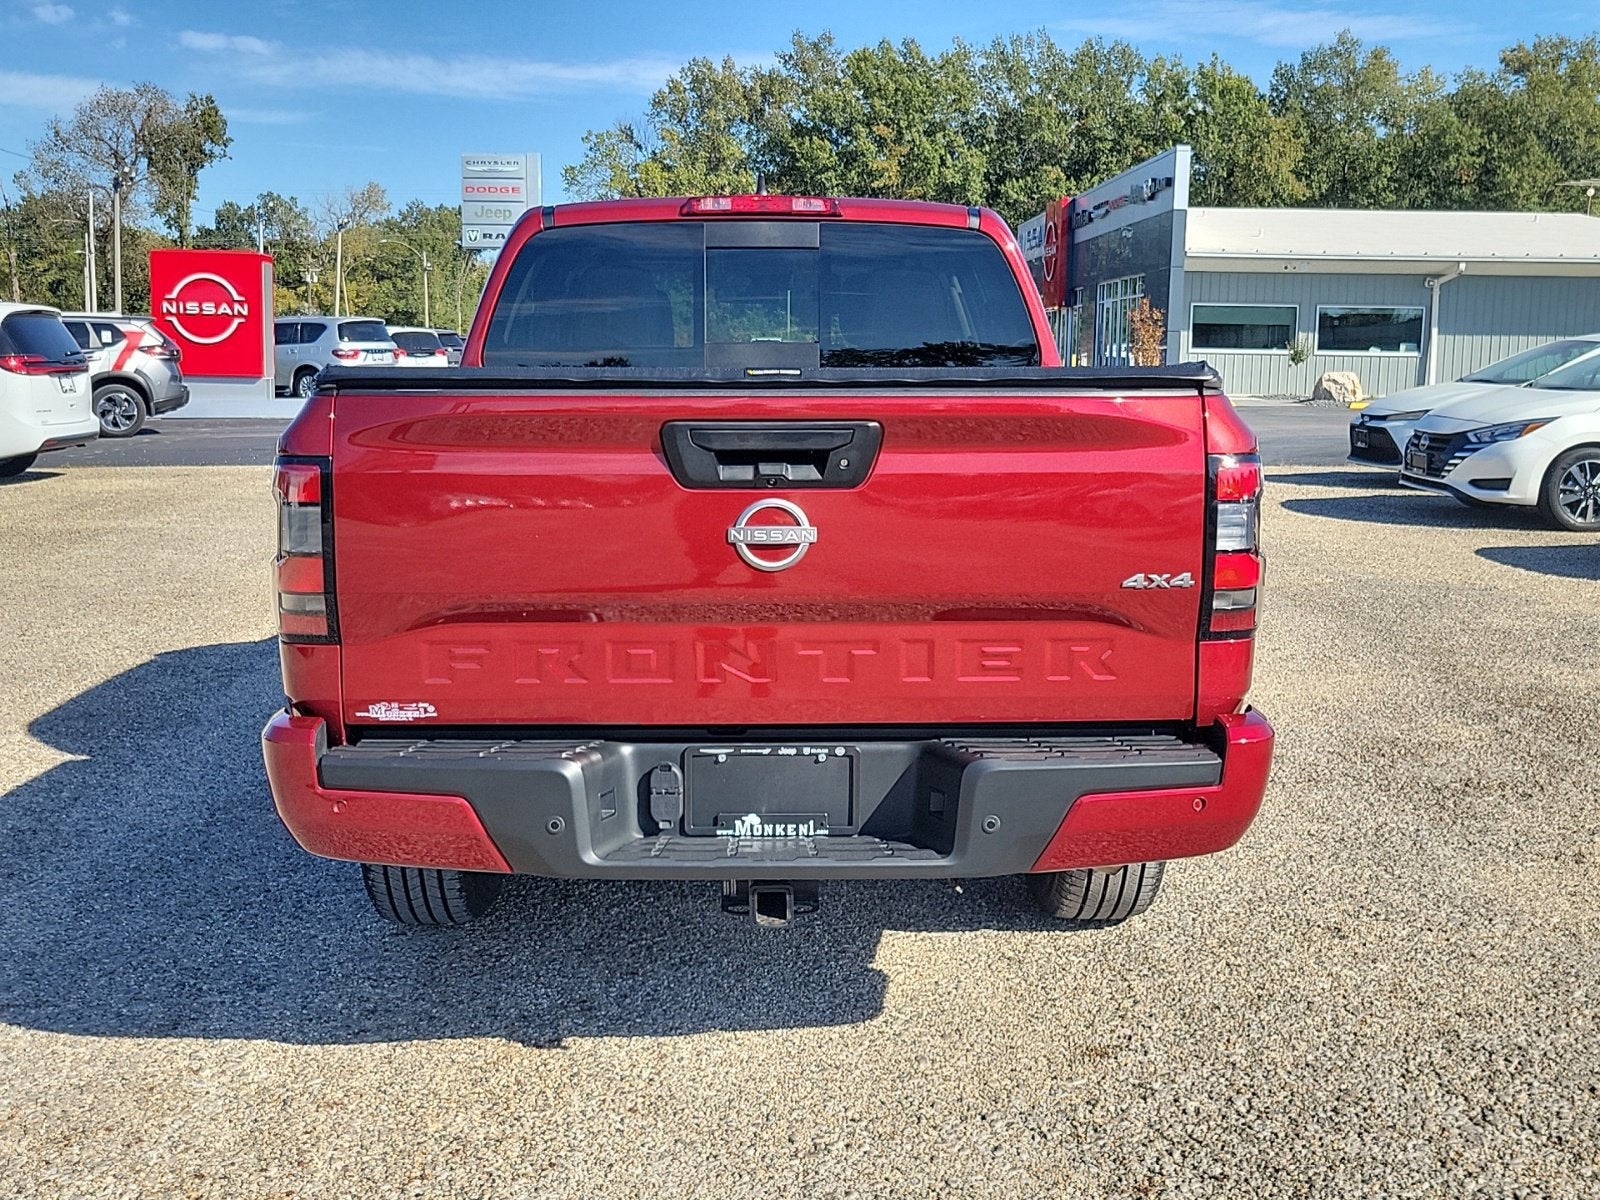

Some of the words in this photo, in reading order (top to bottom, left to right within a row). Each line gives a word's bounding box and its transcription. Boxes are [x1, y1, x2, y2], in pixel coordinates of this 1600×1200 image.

[465, 186, 521, 194] DODGE
[475, 206, 512, 221] Jeep
[162, 301, 249, 316] NISSAN
[730, 529, 815, 541] NISSAN
[422, 640, 1119, 685] FRONTIER
